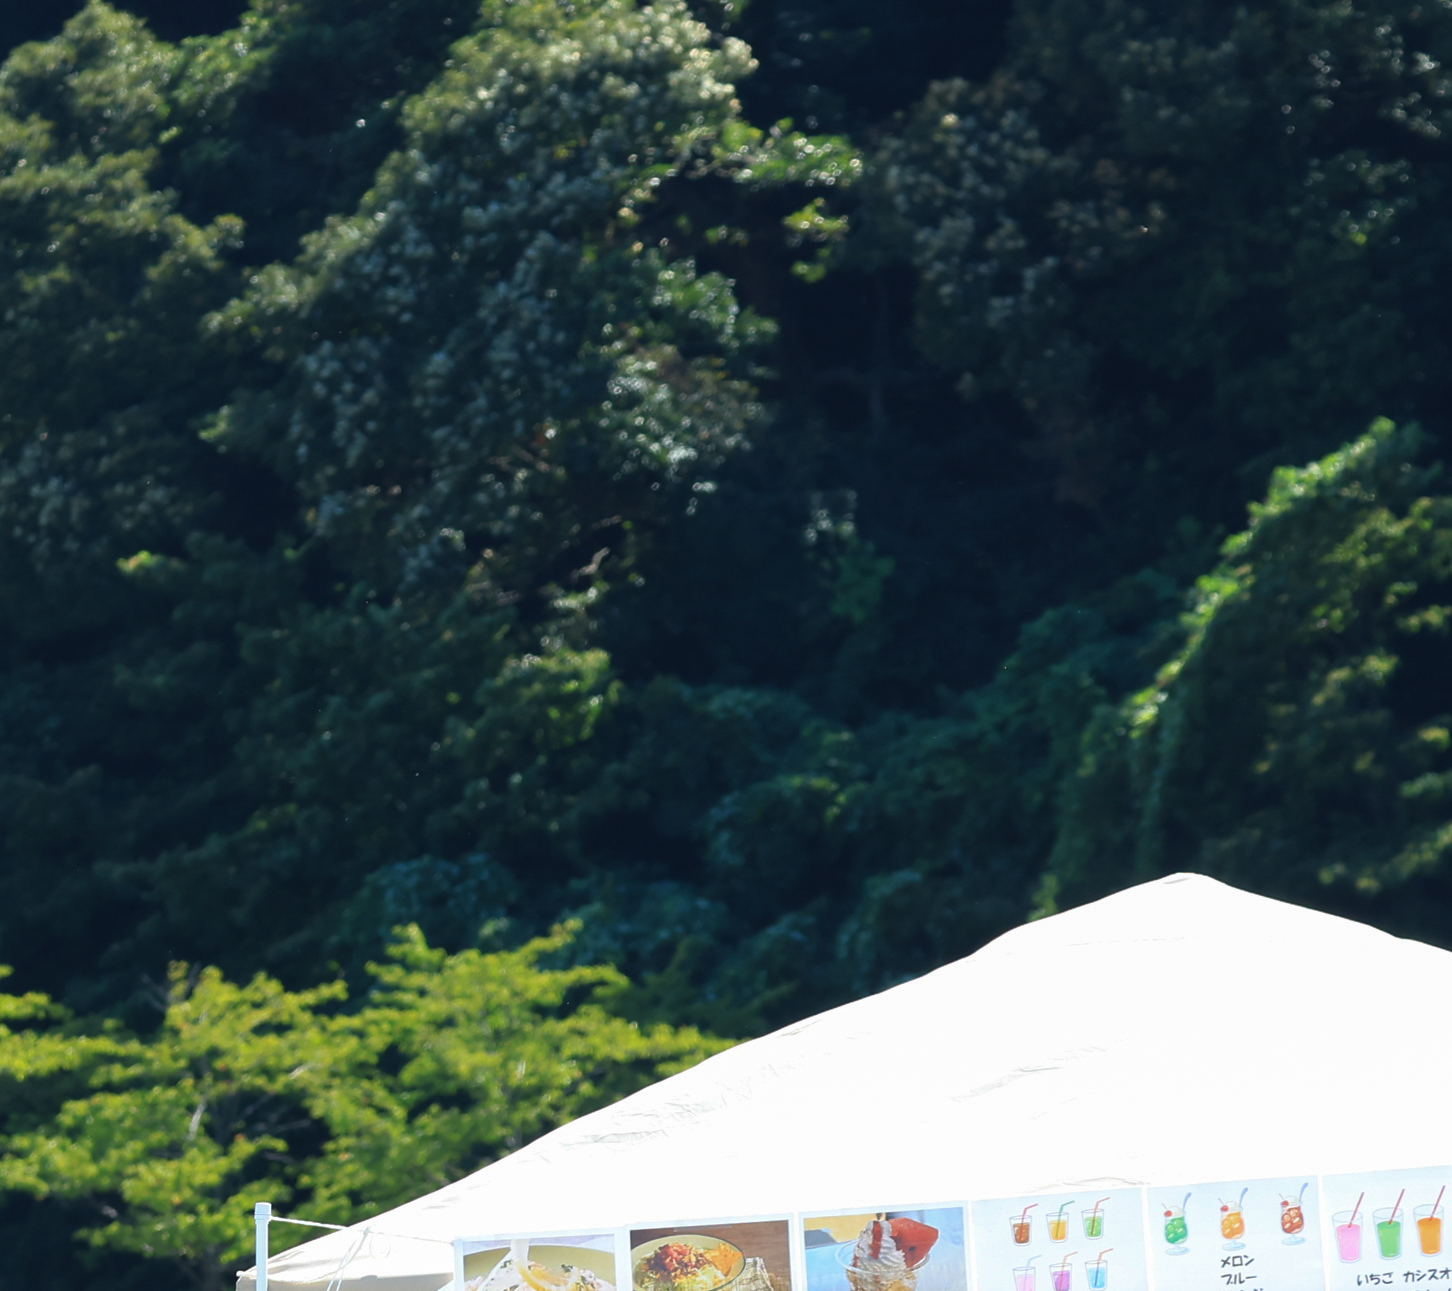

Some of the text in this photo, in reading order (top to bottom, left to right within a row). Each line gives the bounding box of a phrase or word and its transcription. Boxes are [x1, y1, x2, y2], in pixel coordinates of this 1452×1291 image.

[1219, 1255, 1255, 1268] メロン
[1220, 1273, 1258, 1285] ブルー
[1357, 1271, 1394, 1286] いちご
